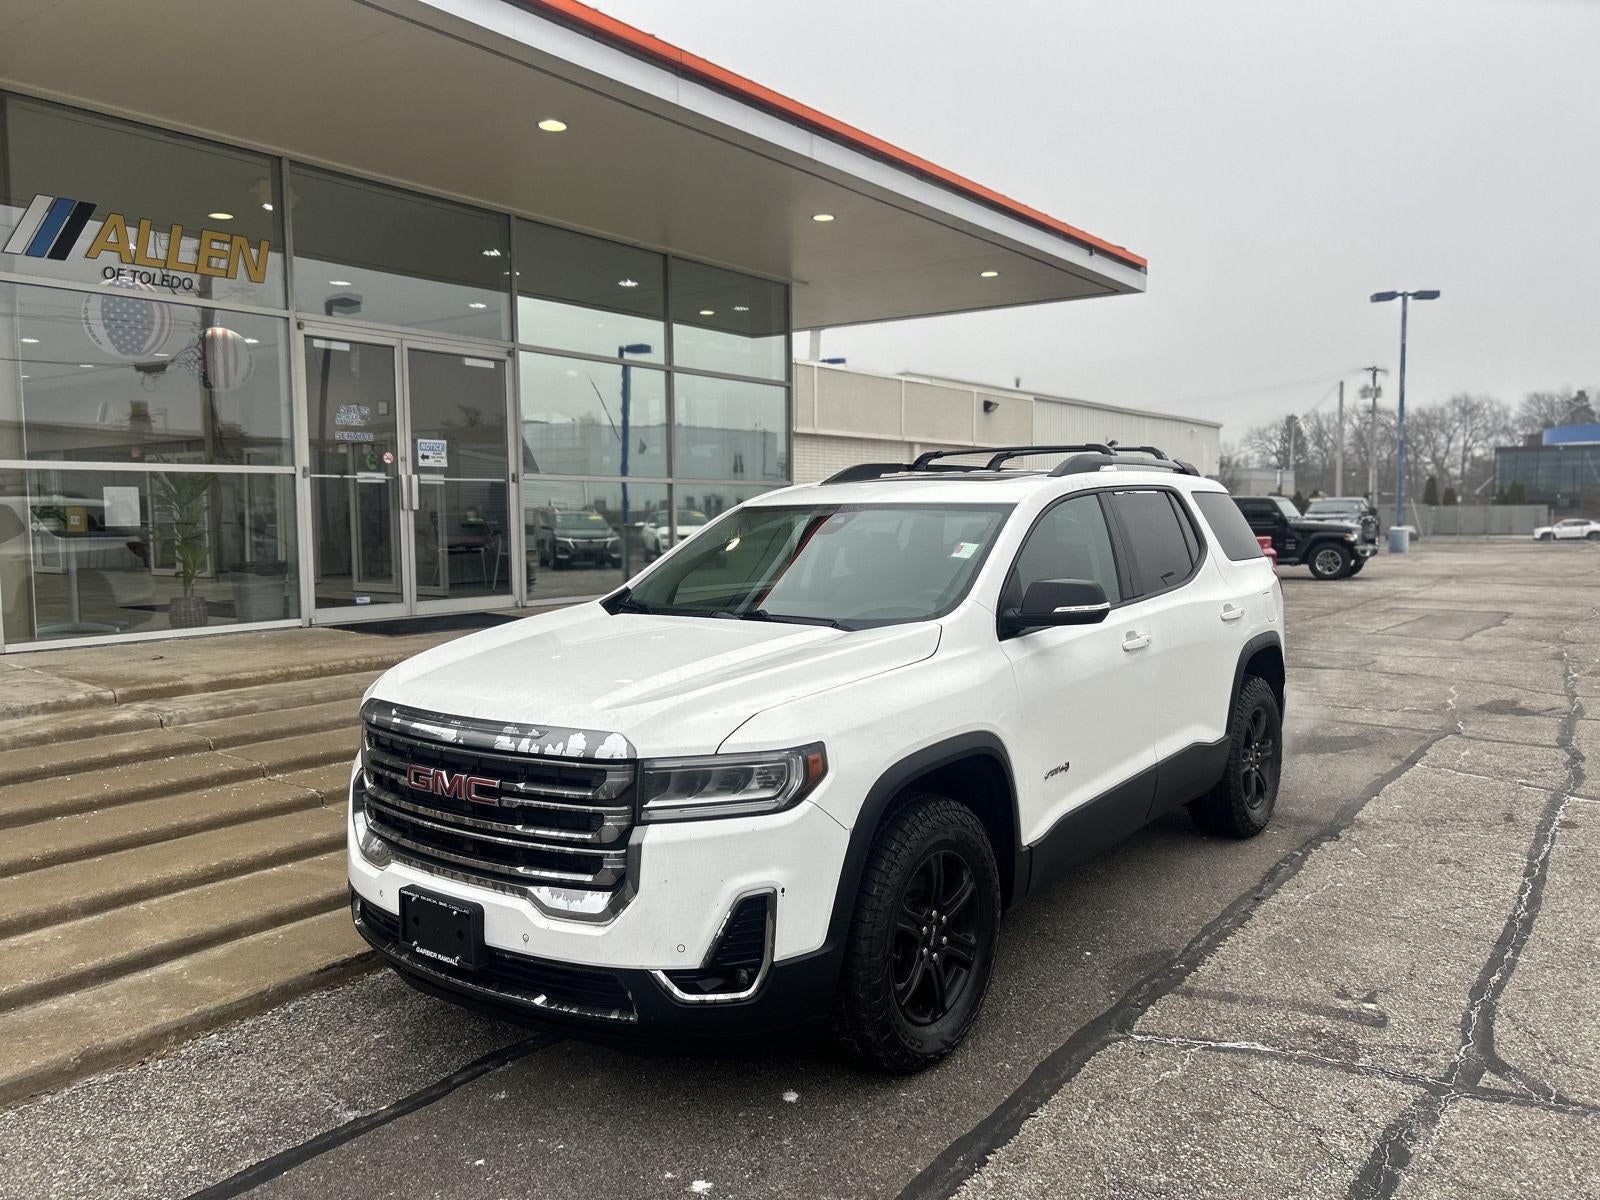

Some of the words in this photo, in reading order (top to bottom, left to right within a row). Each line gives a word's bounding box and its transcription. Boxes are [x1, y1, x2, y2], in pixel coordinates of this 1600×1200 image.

[85, 212, 270, 284] ALLEN
[102, 266, 126, 281] OF
[130, 269, 193, 290] TOLEDO
[340, 404, 369, 415] SALES
[335, 431, 374, 441] SERVICE
[420, 442, 445, 451] NOTICE
[407, 764, 500, 807] GMC
[416, 946, 438, 959] GARBER
[438, 953, 459, 967] RANDALL
